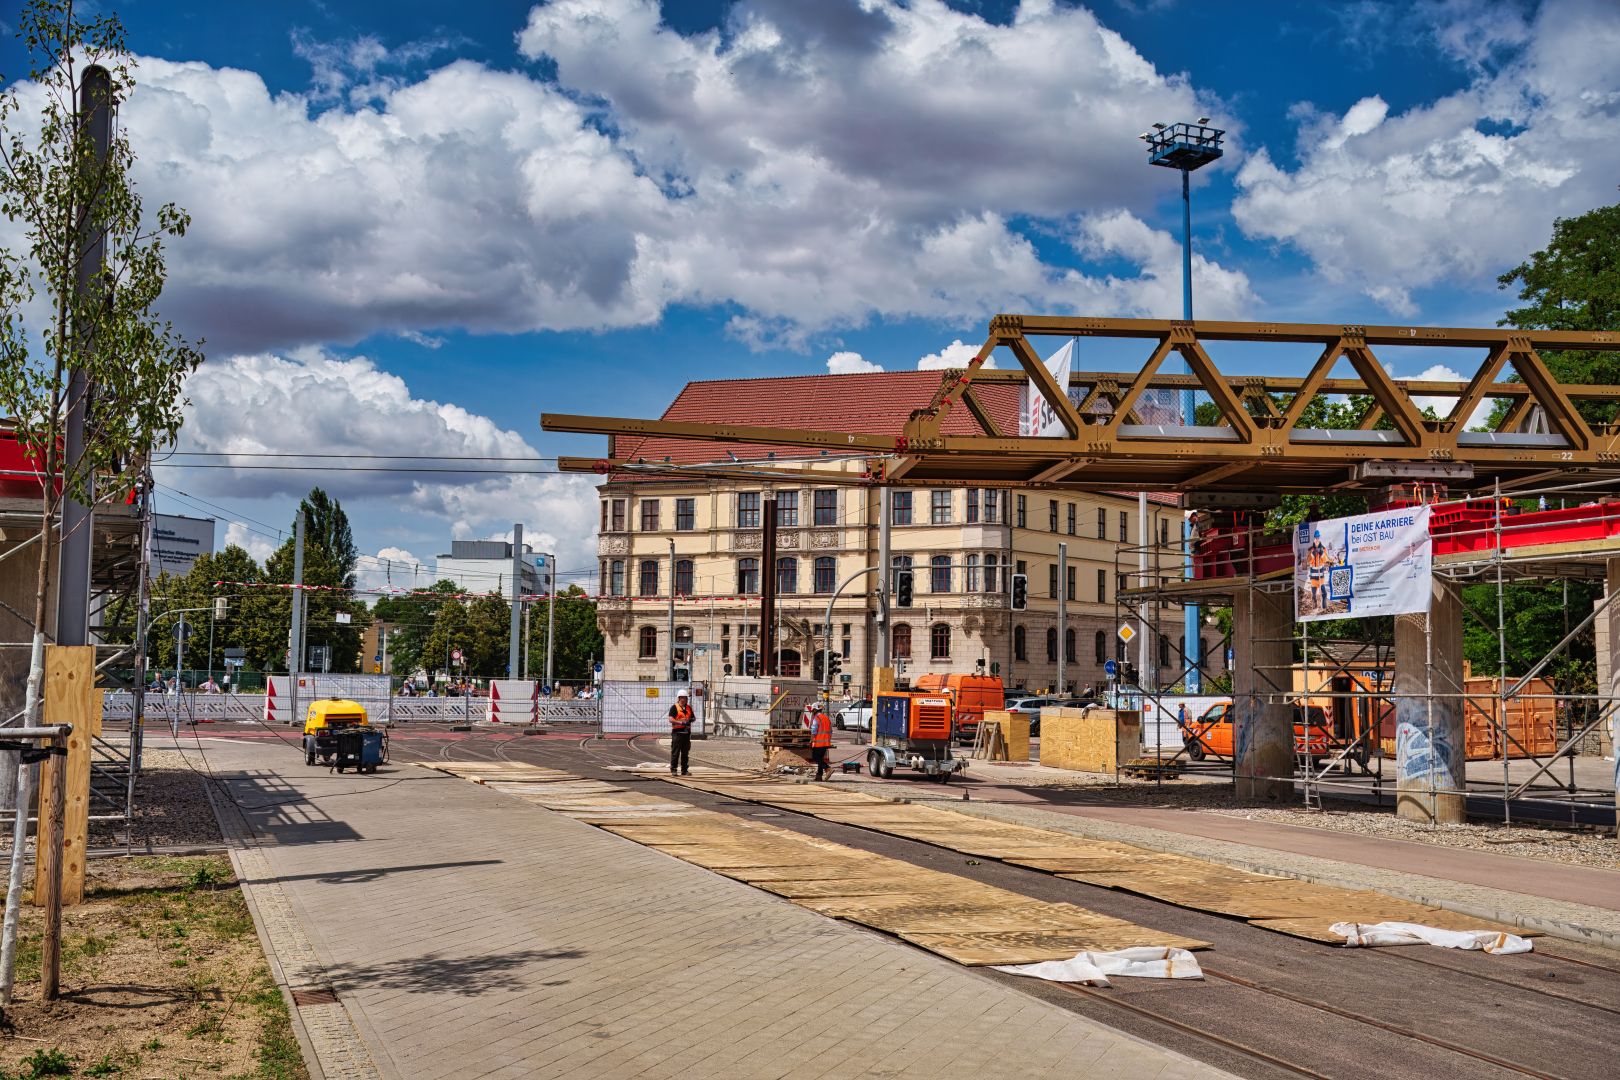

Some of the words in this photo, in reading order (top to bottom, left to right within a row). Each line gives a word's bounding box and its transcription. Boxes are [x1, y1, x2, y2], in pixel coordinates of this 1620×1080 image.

[1561, 452, 1573, 460] 22
[1351, 521, 1373, 533] DEINE
[1375, 516, 1414, 530] KARRIERE
[1351, 535, 1361, 544] bei
[1363, 531, 1377, 543] OST
[1379, 530, 1394, 541] BAU
